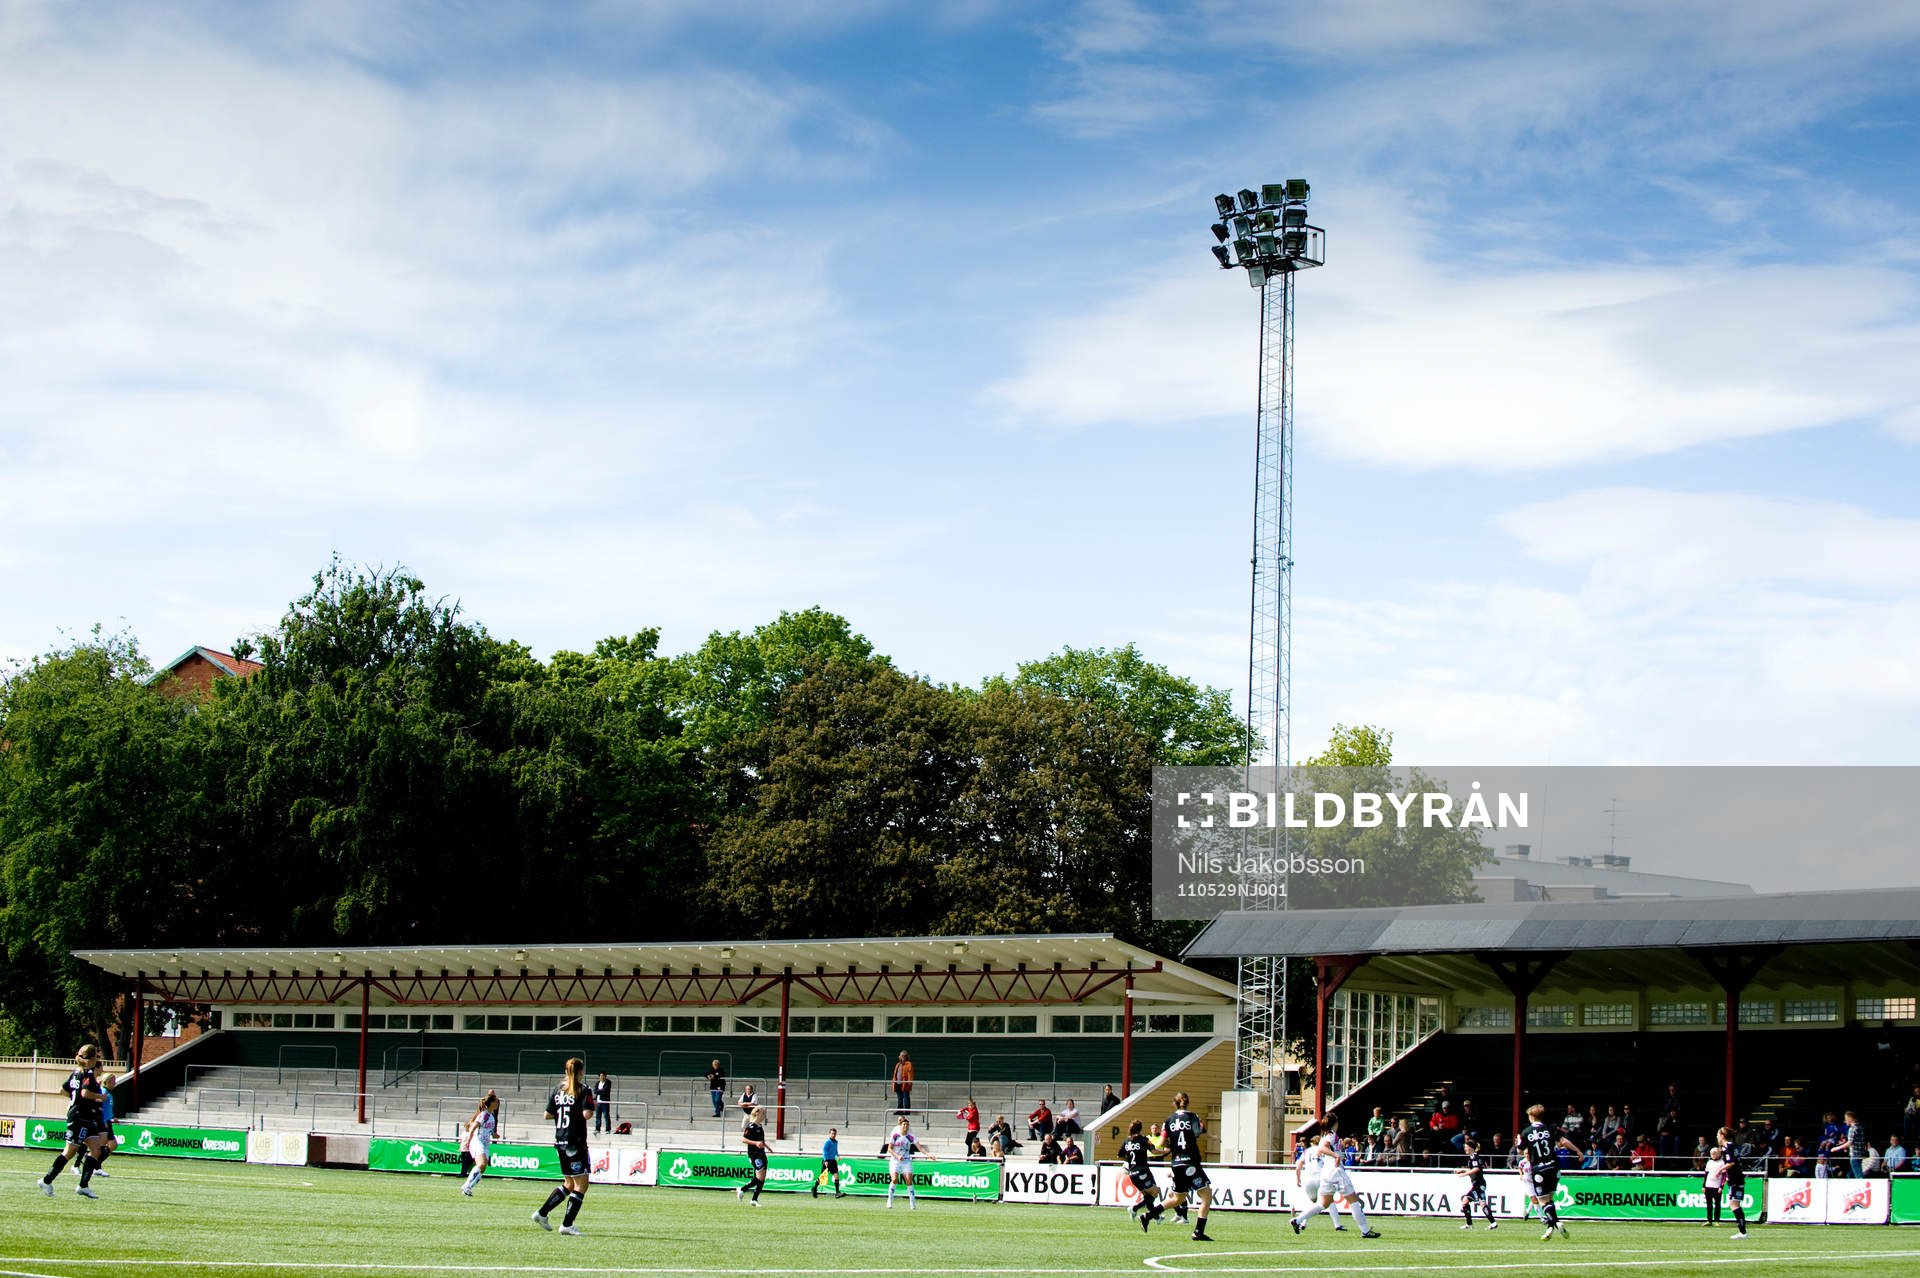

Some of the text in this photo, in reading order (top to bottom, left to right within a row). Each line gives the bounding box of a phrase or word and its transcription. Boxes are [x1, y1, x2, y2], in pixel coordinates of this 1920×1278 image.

[556, 1106, 571, 1129] 15
[1177, 1131, 1187, 1150] 4
[1533, 1140, 1551, 1158] 13
[1129, 1151, 1136, 1165] 2
[1005, 1172, 1084, 1195] KYBOE
[1243, 1189, 1290, 1208] SPEL
